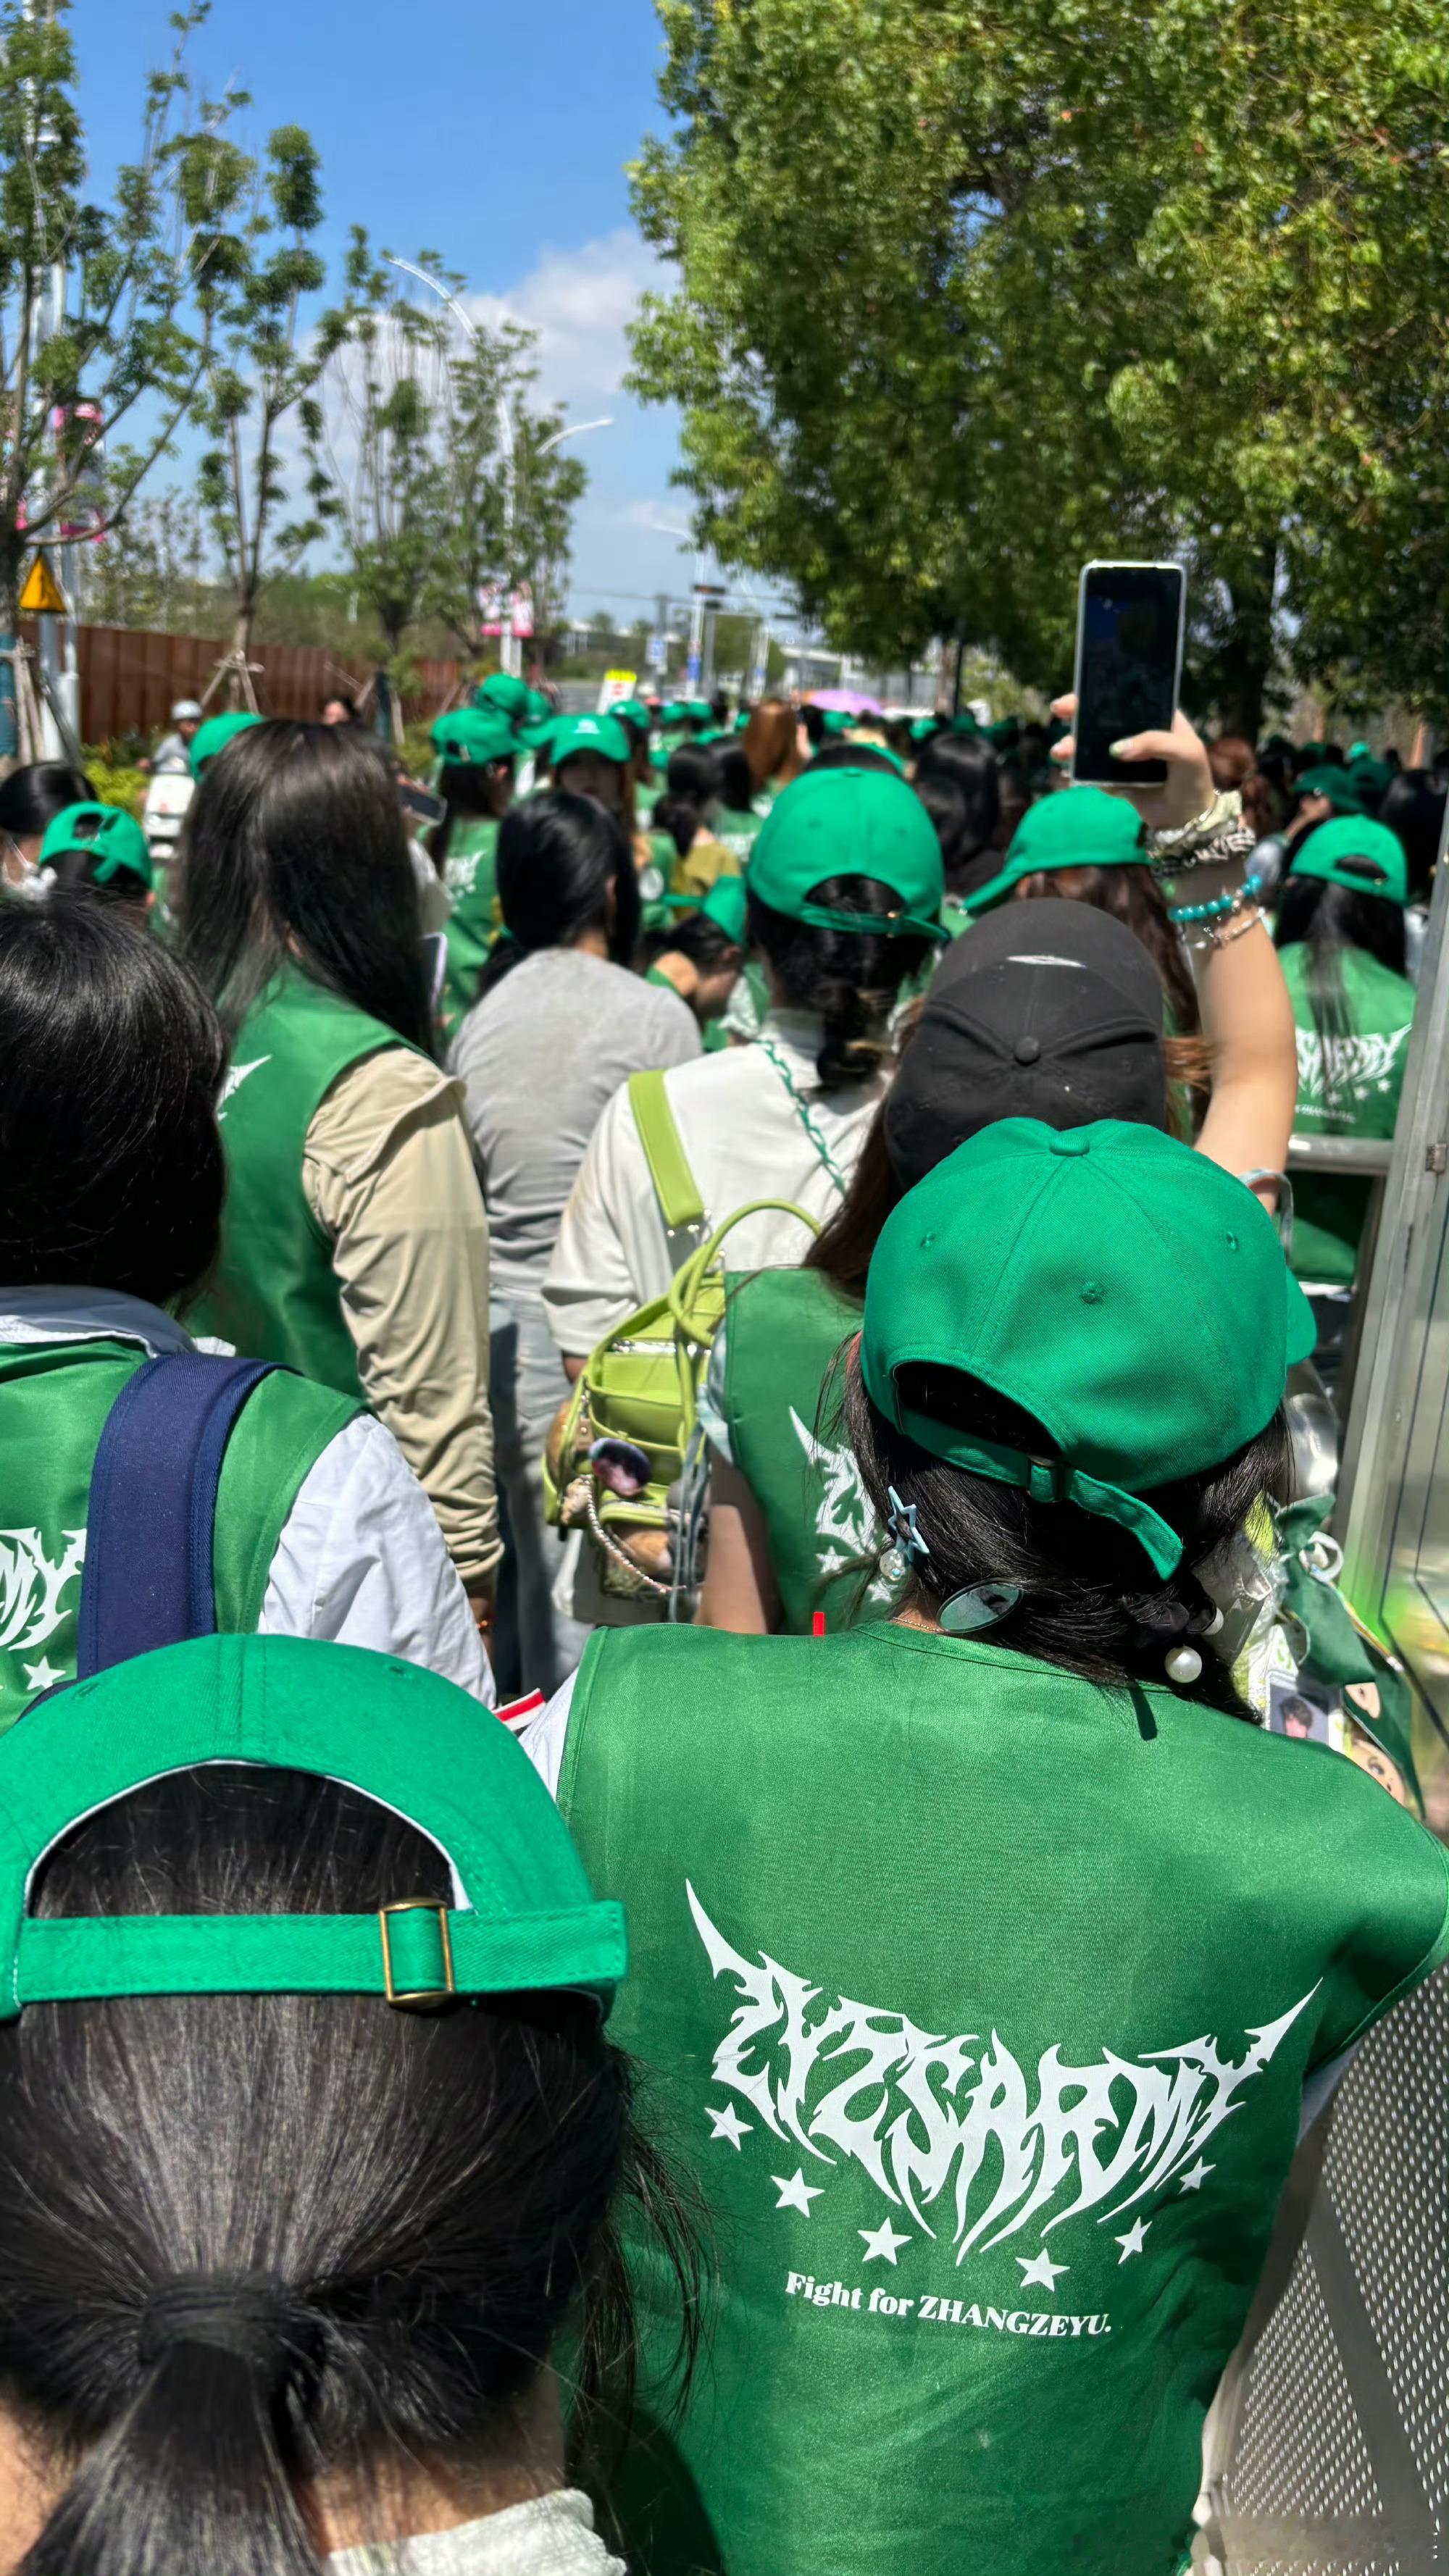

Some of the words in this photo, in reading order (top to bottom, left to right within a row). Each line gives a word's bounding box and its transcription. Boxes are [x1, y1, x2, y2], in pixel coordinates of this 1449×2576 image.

[785, 2271, 863, 2309] Fight
[869, 2288, 914, 2317] for
[917, 2295, 1112, 2336] ZHANGZEYU.
